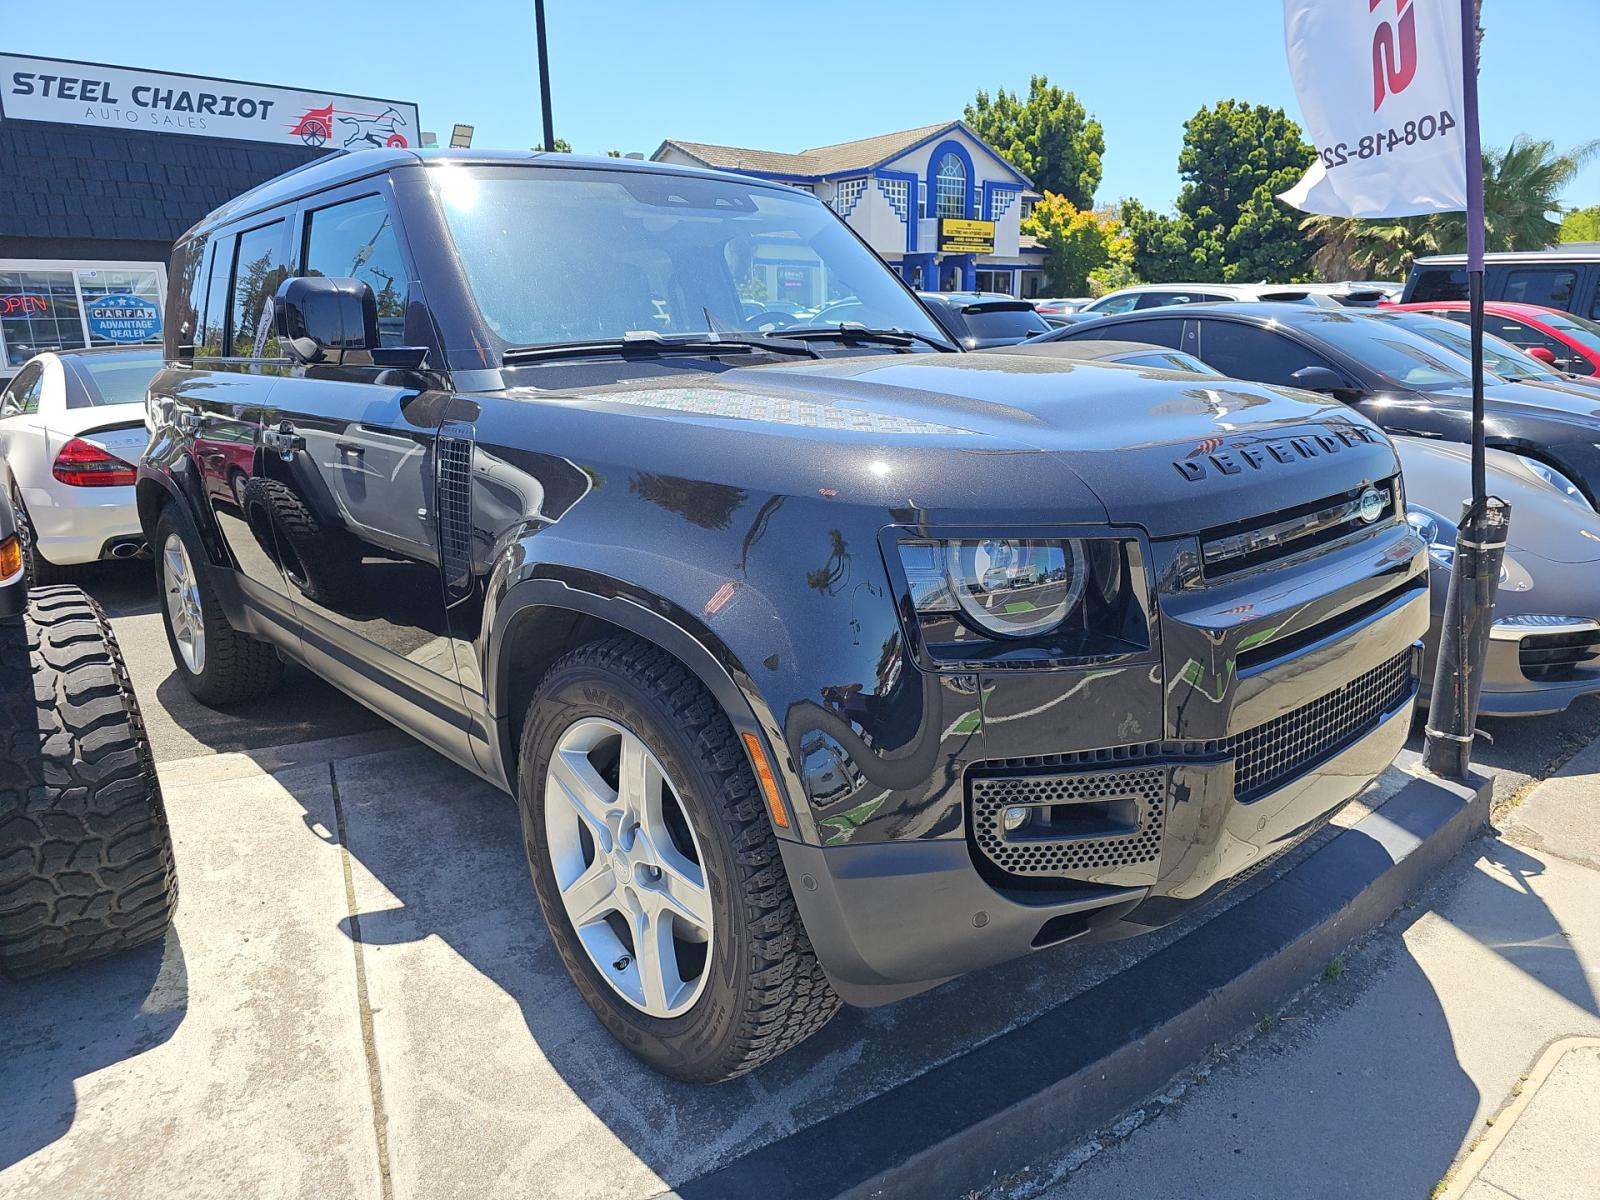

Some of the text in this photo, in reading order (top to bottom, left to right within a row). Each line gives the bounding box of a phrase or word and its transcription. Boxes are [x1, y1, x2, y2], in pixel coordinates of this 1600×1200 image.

[12, 71, 275, 121] STEEL CHARIOT
[85, 106, 207, 131] AUTO SALES
[93, 308, 156, 319] CARFAX
[100, 320, 153, 329] ADVANTAGE
[110, 329, 146, 338] DEALER
[1172, 426, 1379, 482] DEFENDER
